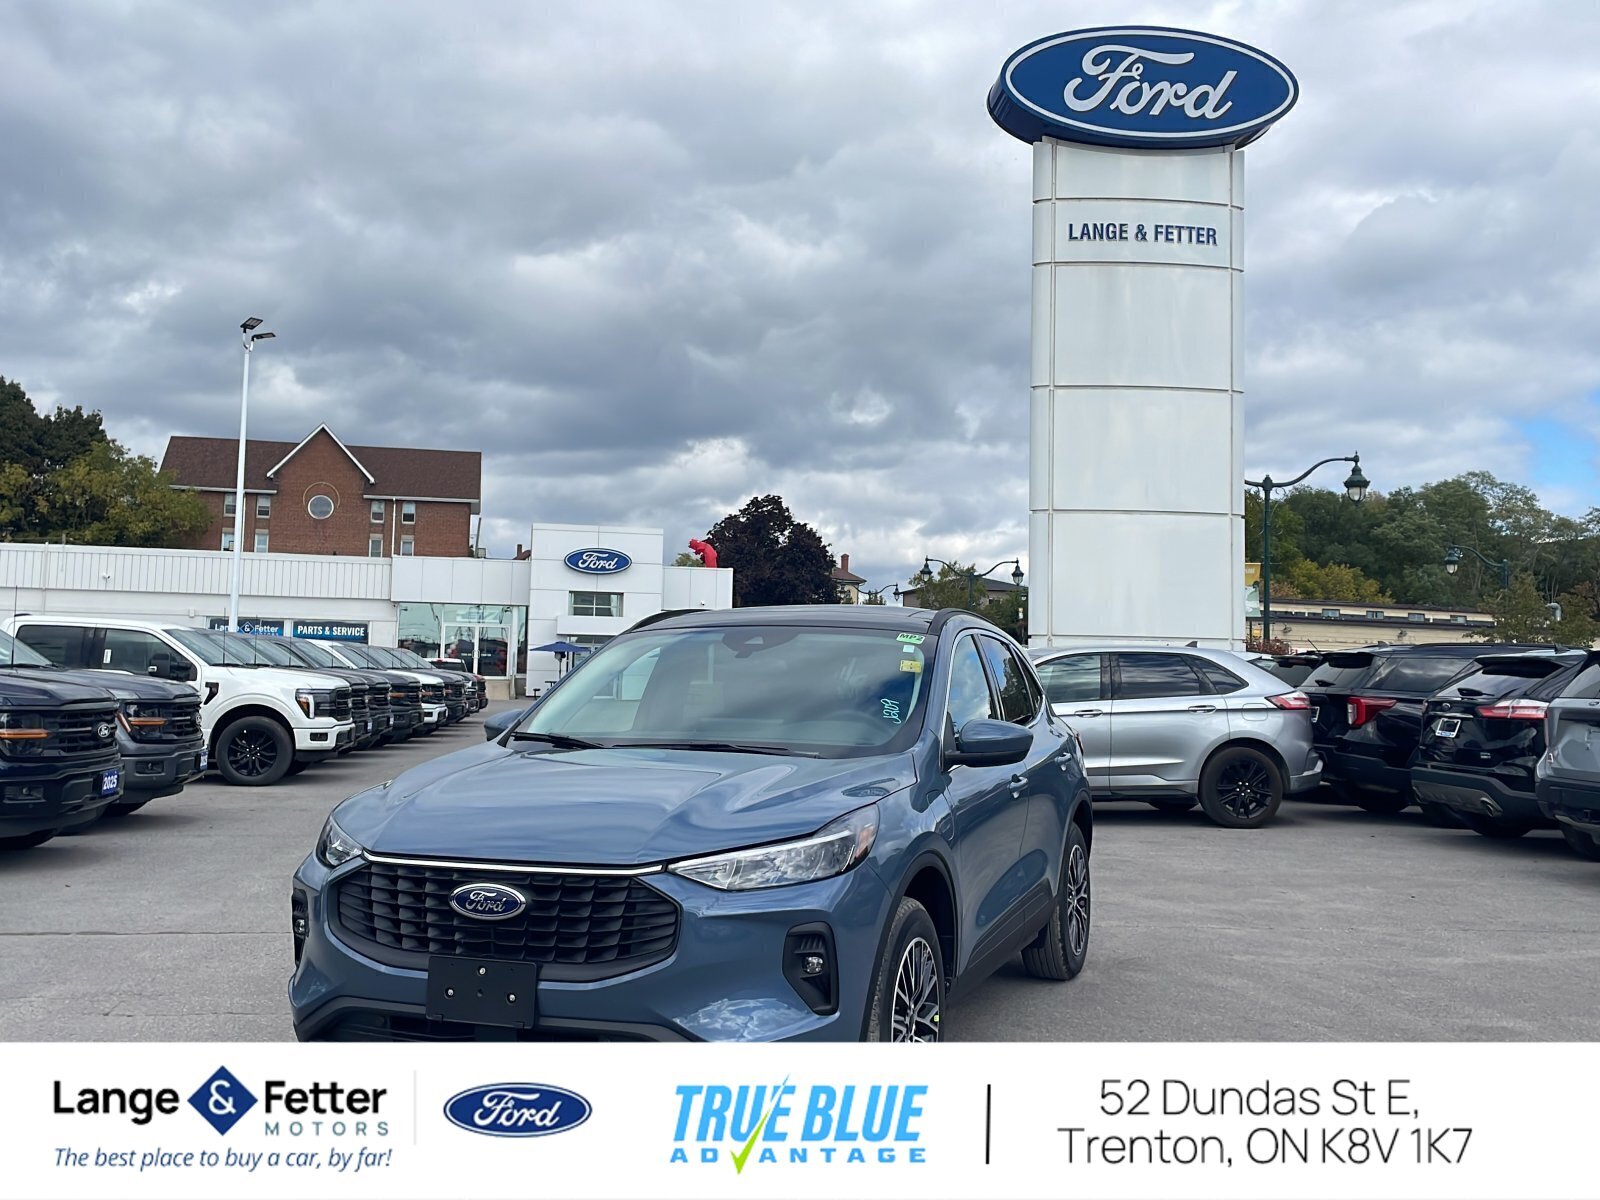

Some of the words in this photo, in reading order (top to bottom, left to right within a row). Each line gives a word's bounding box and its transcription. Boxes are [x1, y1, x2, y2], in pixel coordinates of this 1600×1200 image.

[1063, 44, 1238, 119] Ford
[1068, 223, 1129, 242] LANGE
[1135, 223, 1148, 242] &
[1154, 224, 1218, 246] FETTER
[578, 552, 618, 569] Ford
[297, 625, 323, 635] PARTS
[324, 627, 330, 635] &
[332, 627, 365, 636] SERVICE
[103, 775, 118, 790] 2025
[465, 890, 507, 911] Ford
